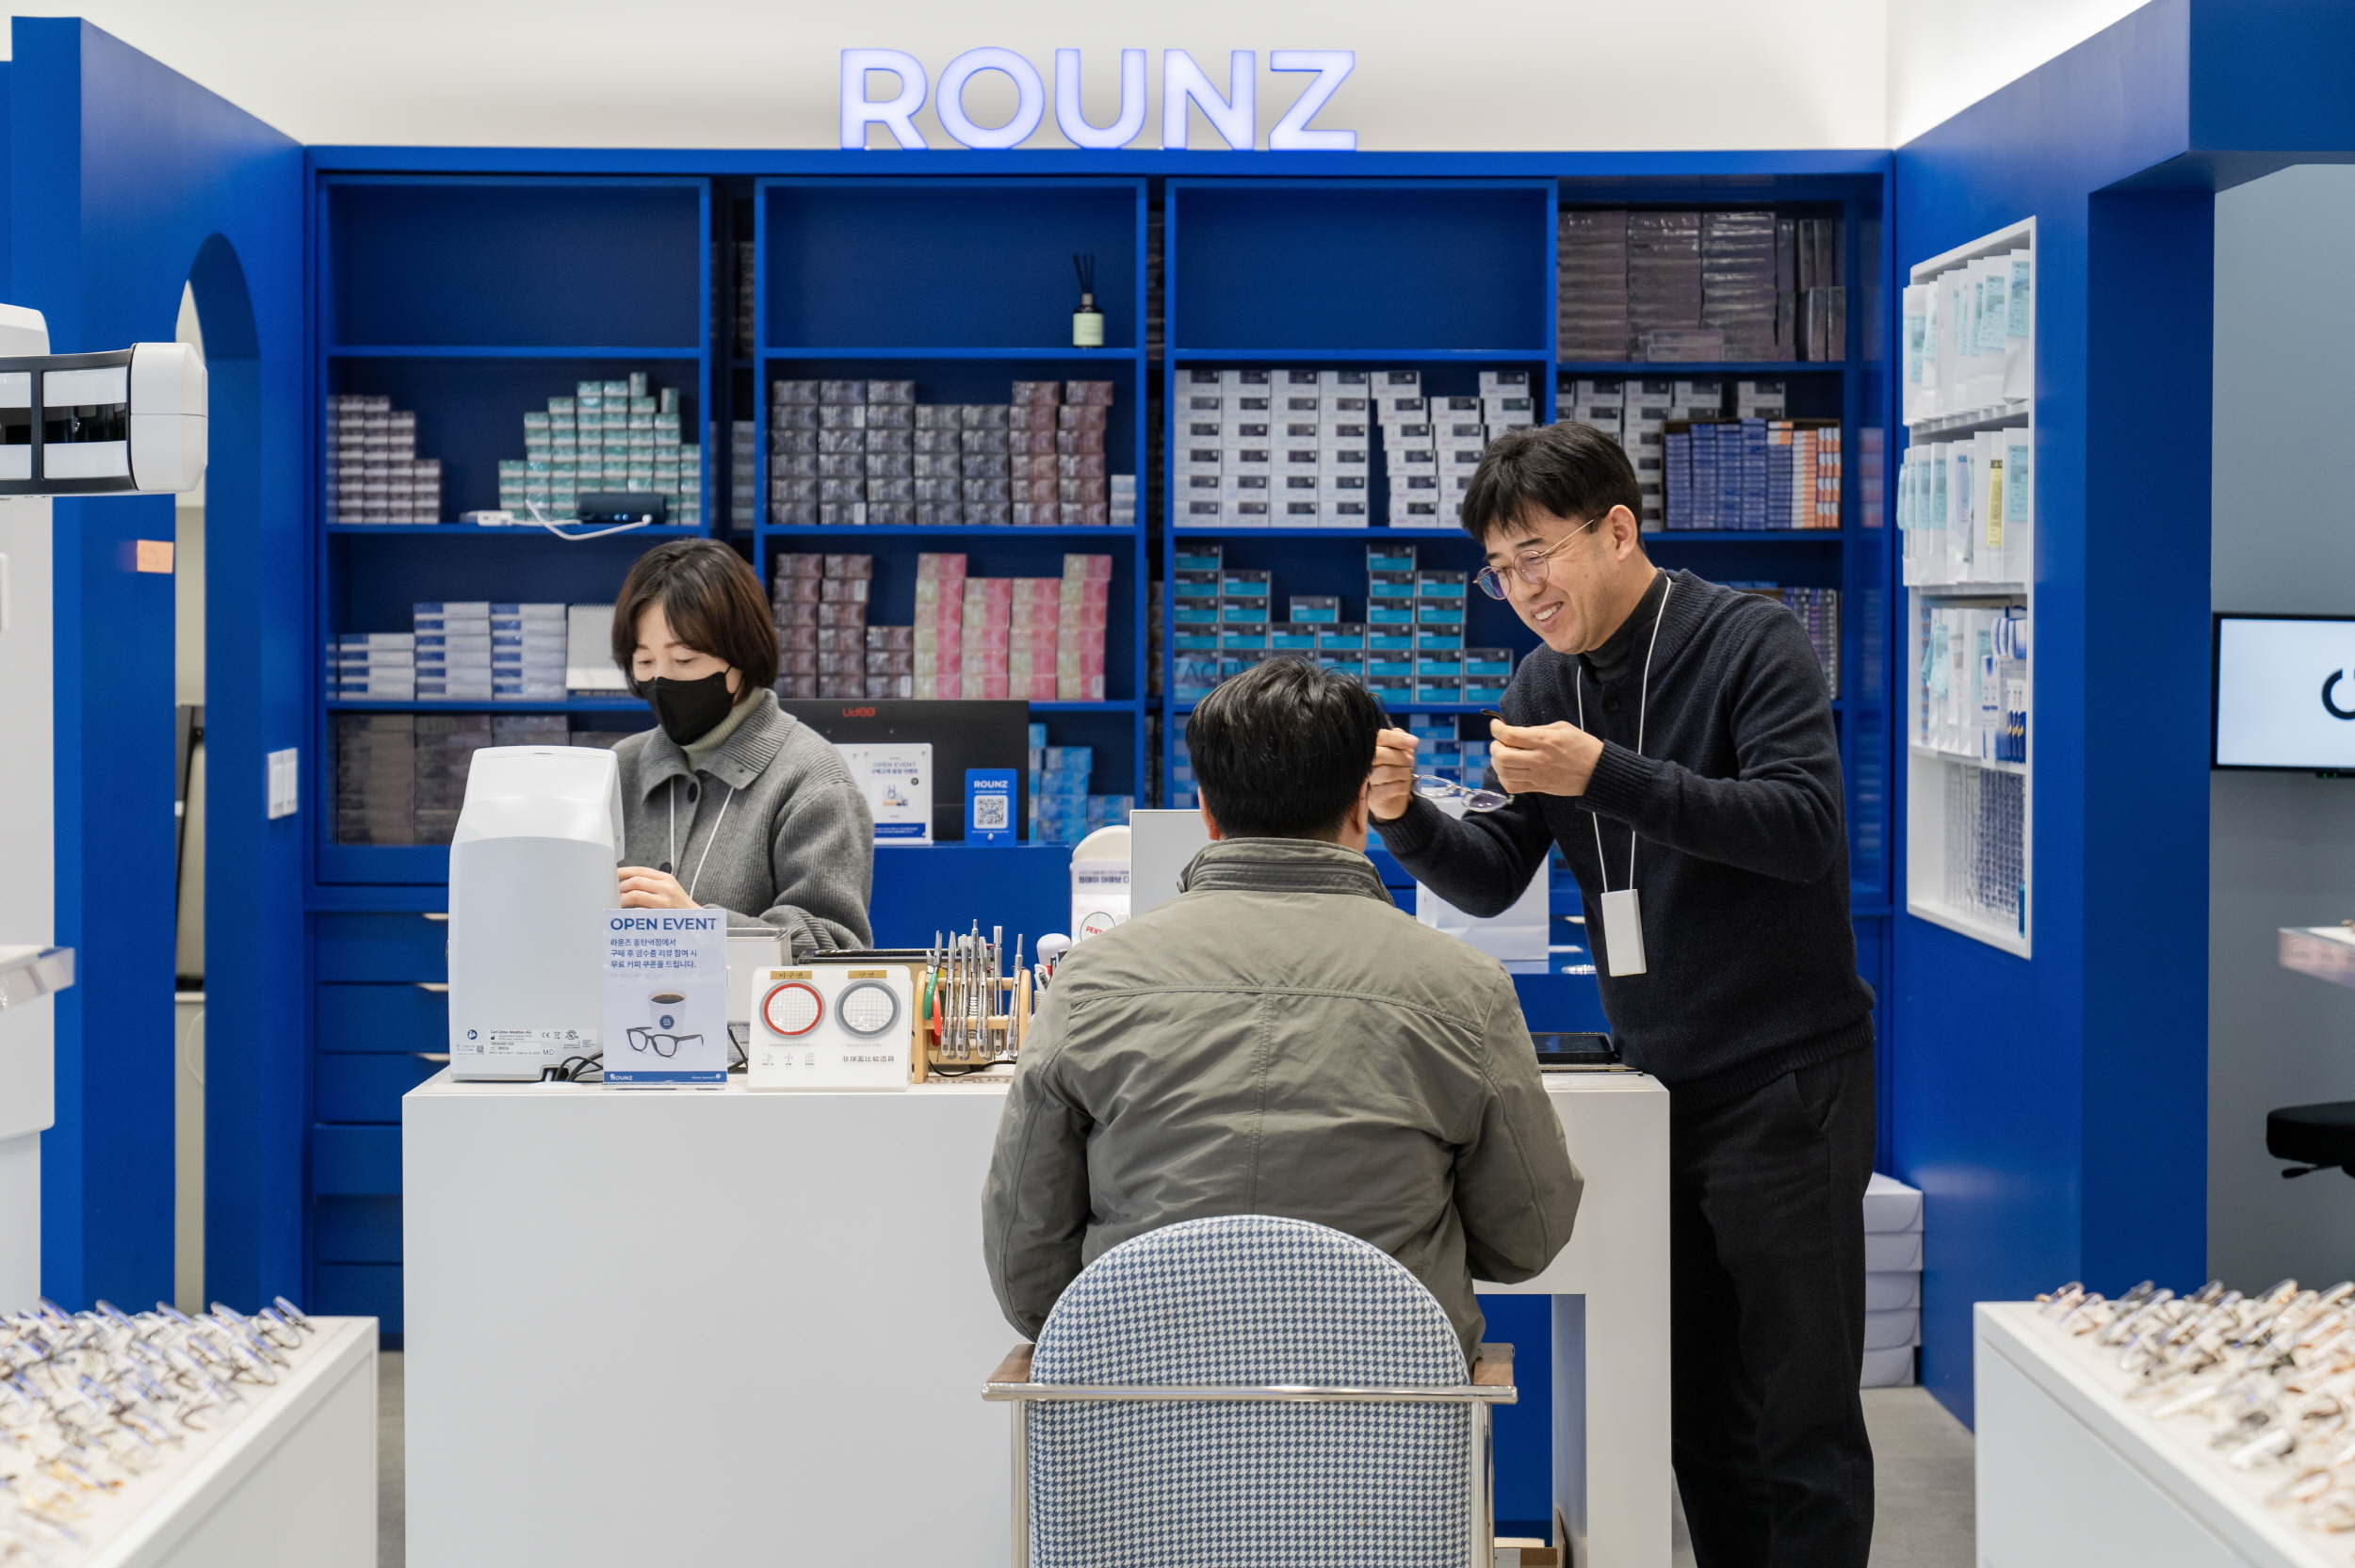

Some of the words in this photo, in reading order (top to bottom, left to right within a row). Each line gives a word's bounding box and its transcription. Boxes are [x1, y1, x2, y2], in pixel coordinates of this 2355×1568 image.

[839, 46, 1357, 151] ROUNZ
[973, 780, 1008, 789] ROUNZ
[609, 917, 658, 930] OPEN
[663, 917, 717, 930] EVENT
[610, 938, 632, 946] 라운즈
[610, 949, 625, 958] 구매
[626, 949, 634, 958] 후
[635, 949, 657, 958] 영수증
[658, 949, 673, 958] 리뷰
[674, 949, 689, 958] 참여
[690, 949, 697, 958] 시
